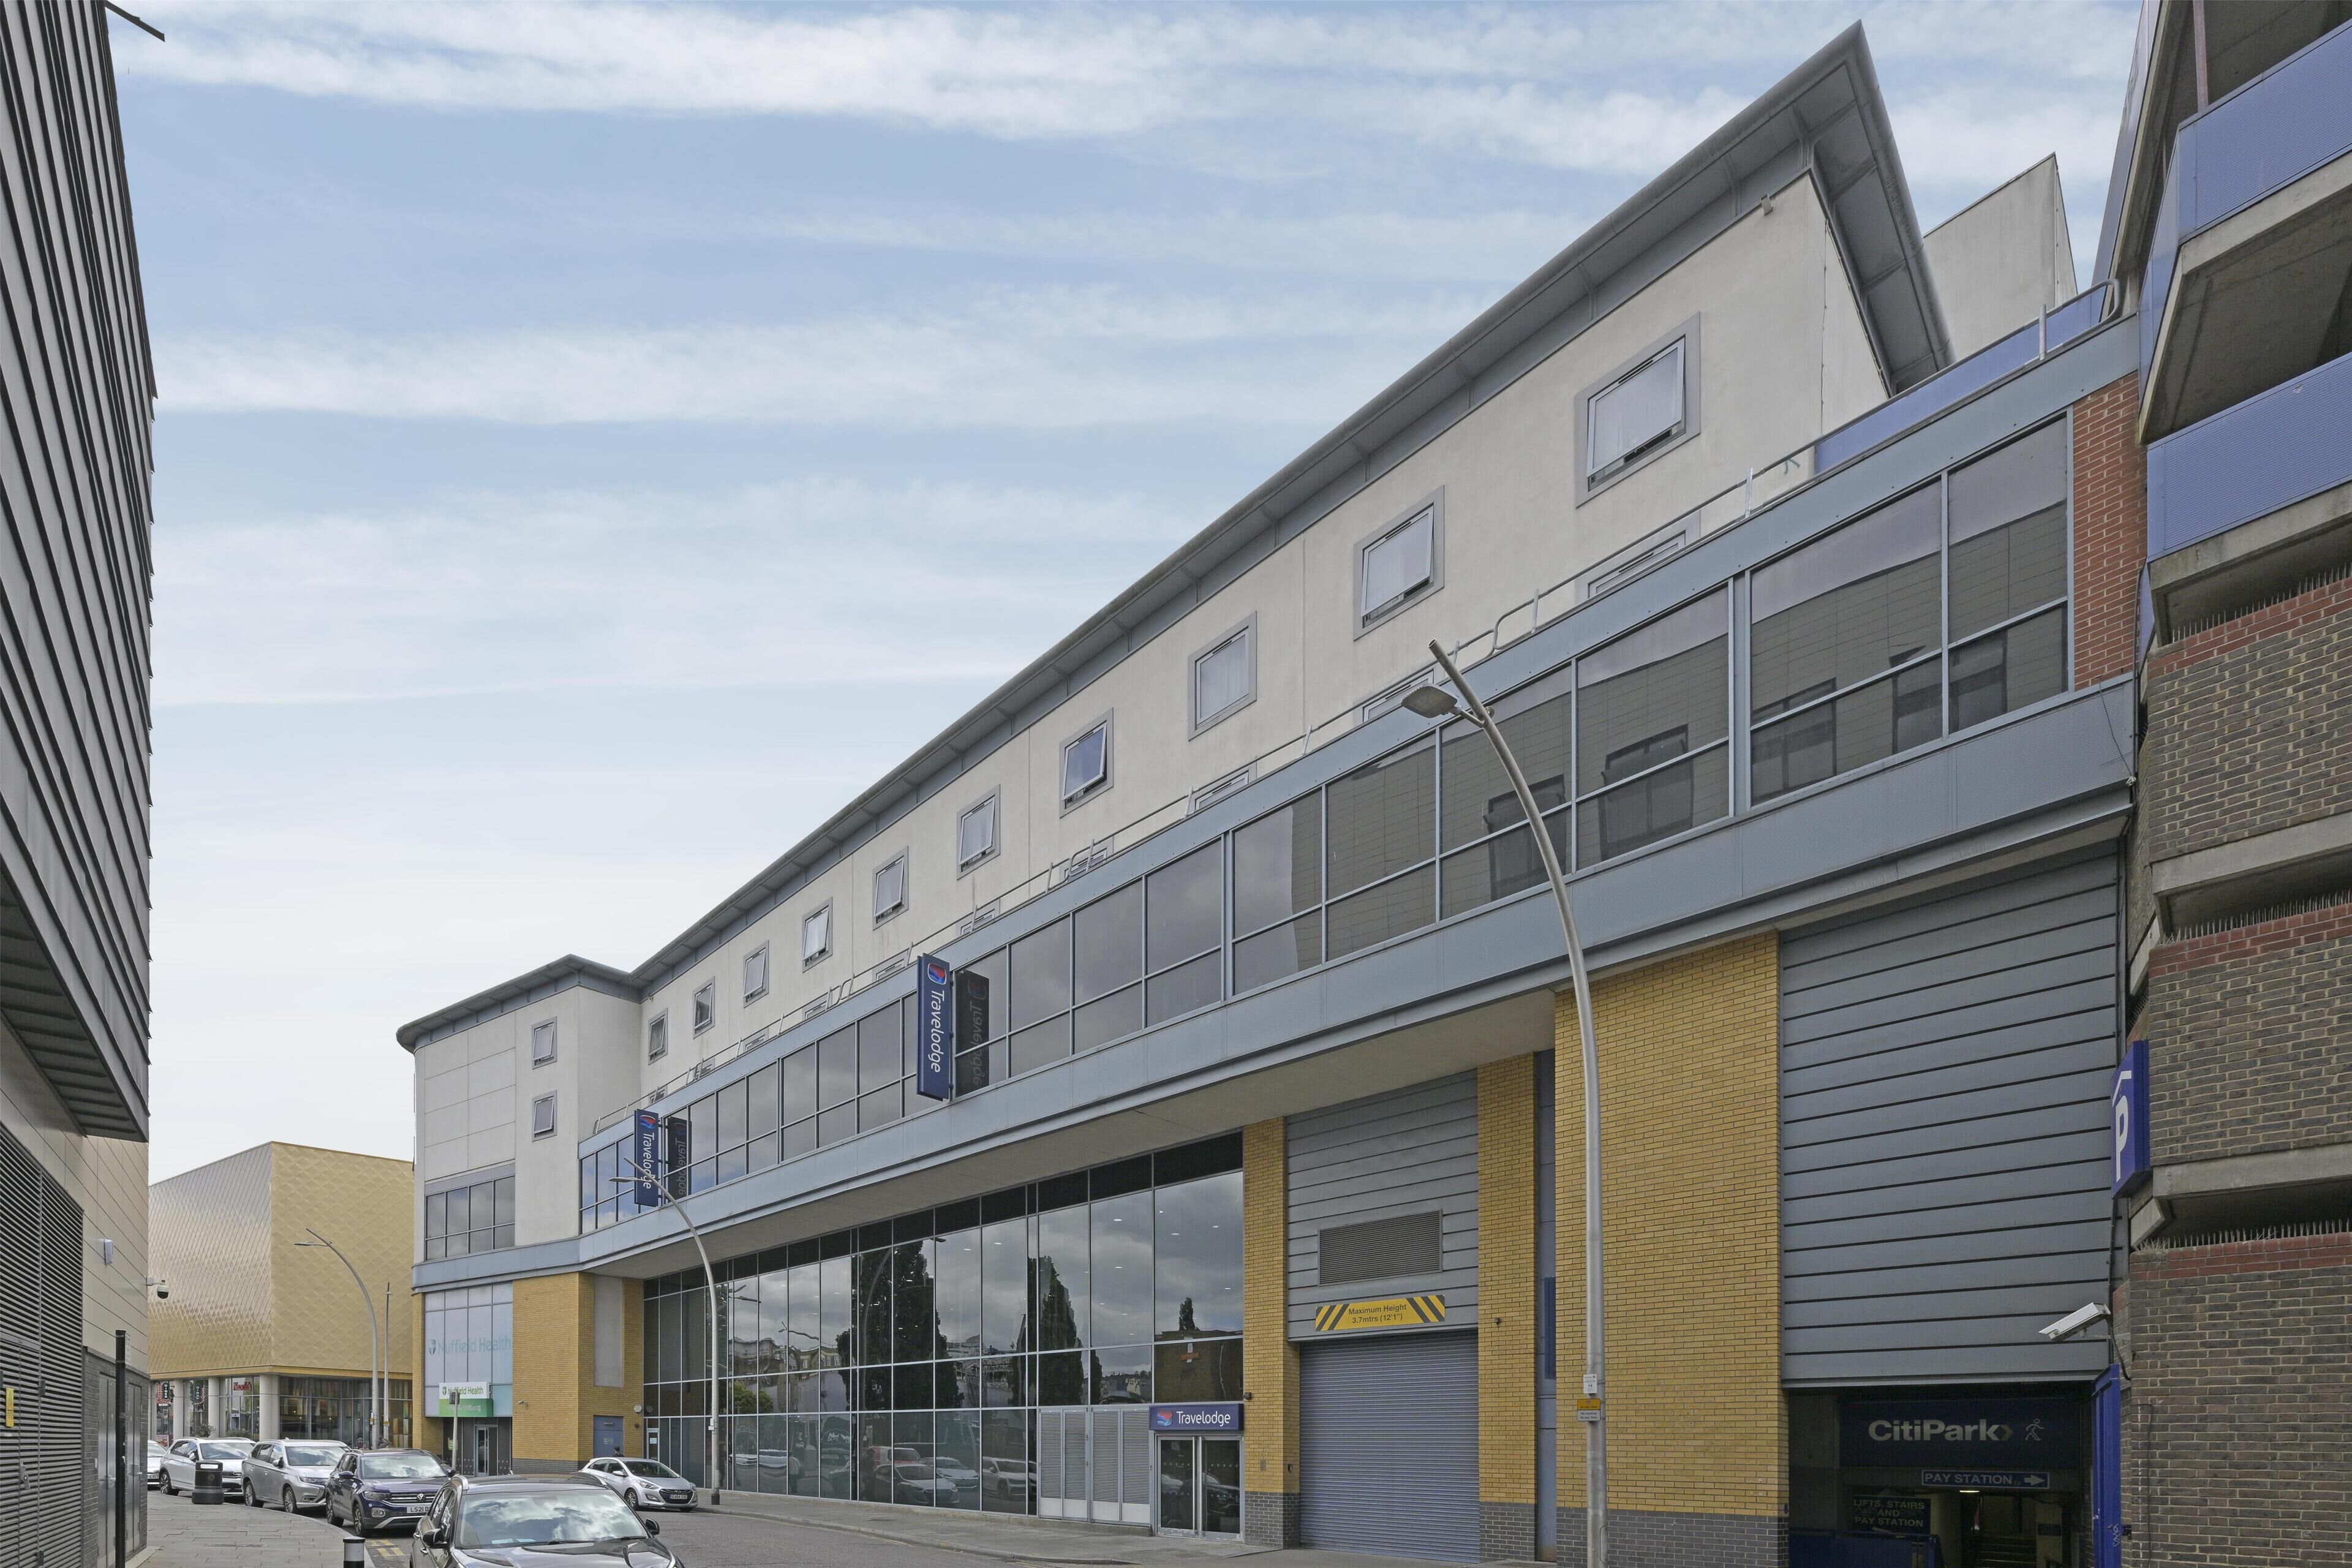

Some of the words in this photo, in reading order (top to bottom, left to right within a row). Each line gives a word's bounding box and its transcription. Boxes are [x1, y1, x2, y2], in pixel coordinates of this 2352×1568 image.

[928, 990, 944, 1073] Travelodge
[2116, 1095, 2128, 1183] P
[641, 1132, 654, 1189] Travelodge
[1348, 1306, 1382, 1315] Maximum
[1384, 1303, 1407, 1313] Height
[1380, 1313, 1403, 1323] (12'1")
[437, 1338, 477, 1354] Nuffield
[480, 1335, 511, 1352] Health
[468, 1386, 483, 1395] Health
[1176, 1411, 1231, 1427] Travelodge
[1868, 1419, 2000, 1441] CitiPark
[1925, 1473, 1950, 1482] PAY
[1954, 1474, 2012, 1485] STATION
[1853, 1498, 1882, 1509] LIFTS,
[1887, 1501, 1925, 1510] STAIRS
[1854, 1516, 1875, 1525] PAY
[1878, 1518, 1923, 1527] STATION
